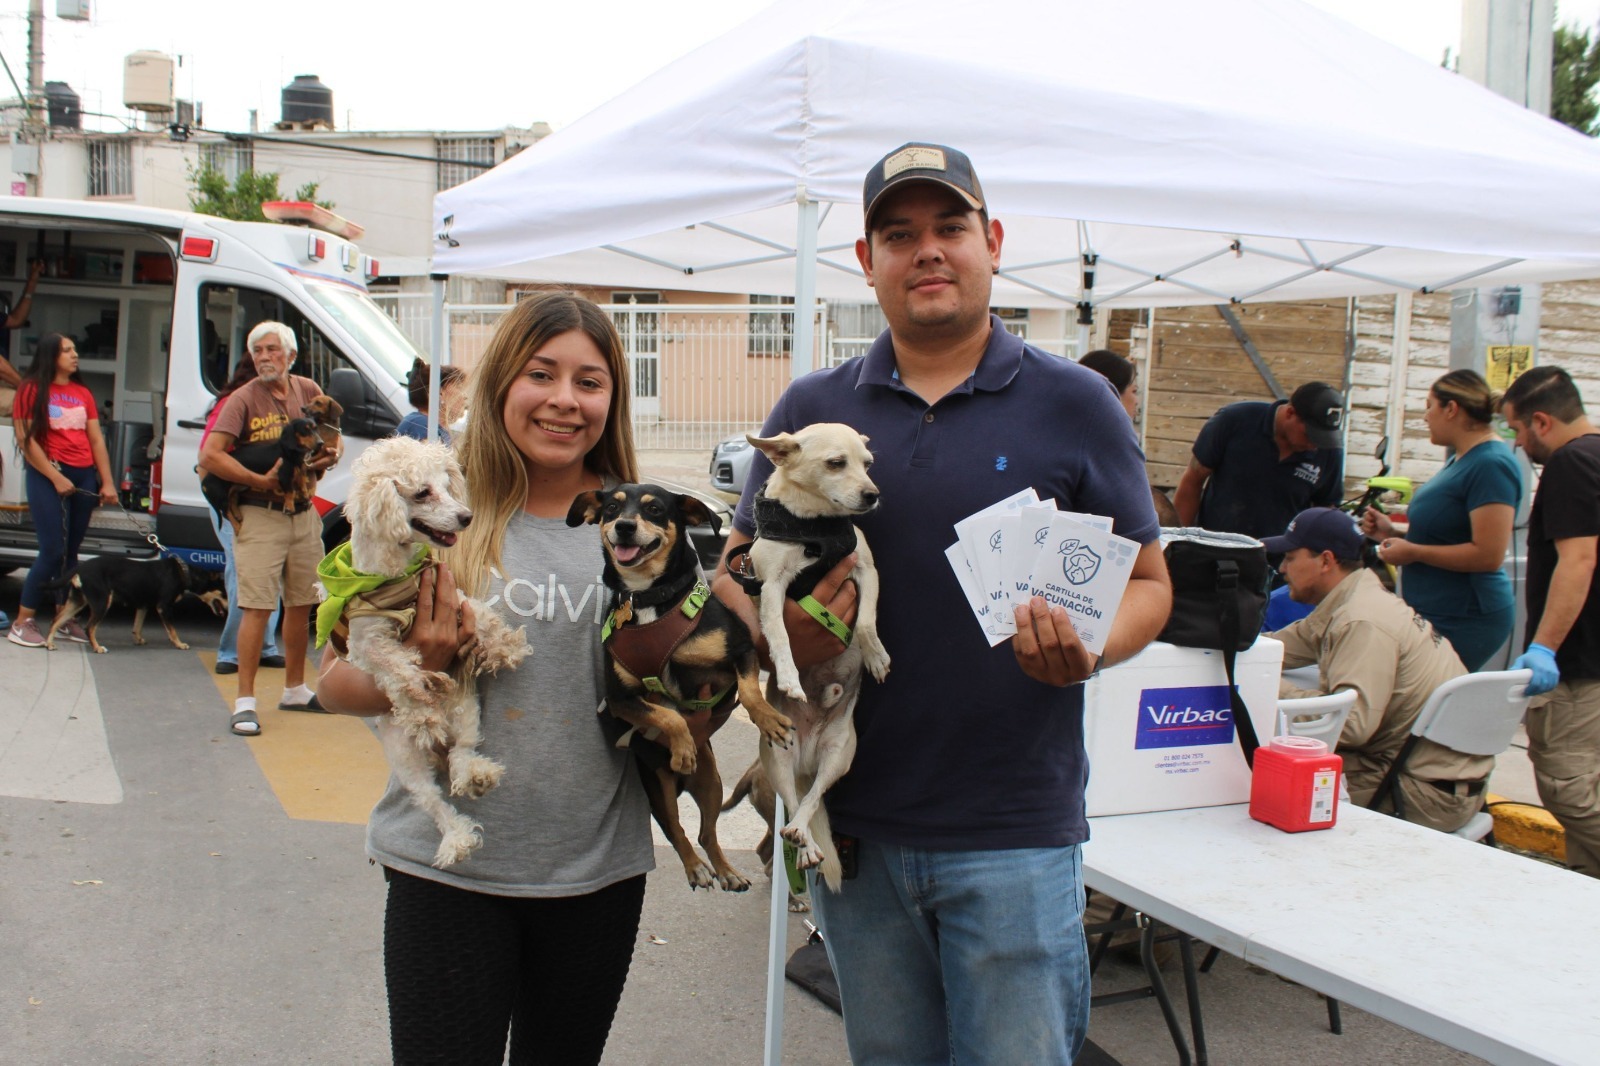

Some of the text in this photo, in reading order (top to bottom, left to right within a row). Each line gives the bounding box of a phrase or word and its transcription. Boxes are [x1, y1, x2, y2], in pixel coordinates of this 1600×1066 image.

[483, 567, 607, 624] alvi
[1031, 587, 1103, 620] VACUNACIÓN
[1045, 583, 1094, 605] CARTILLA DE
[1147, 705, 1231, 725] Virbac
